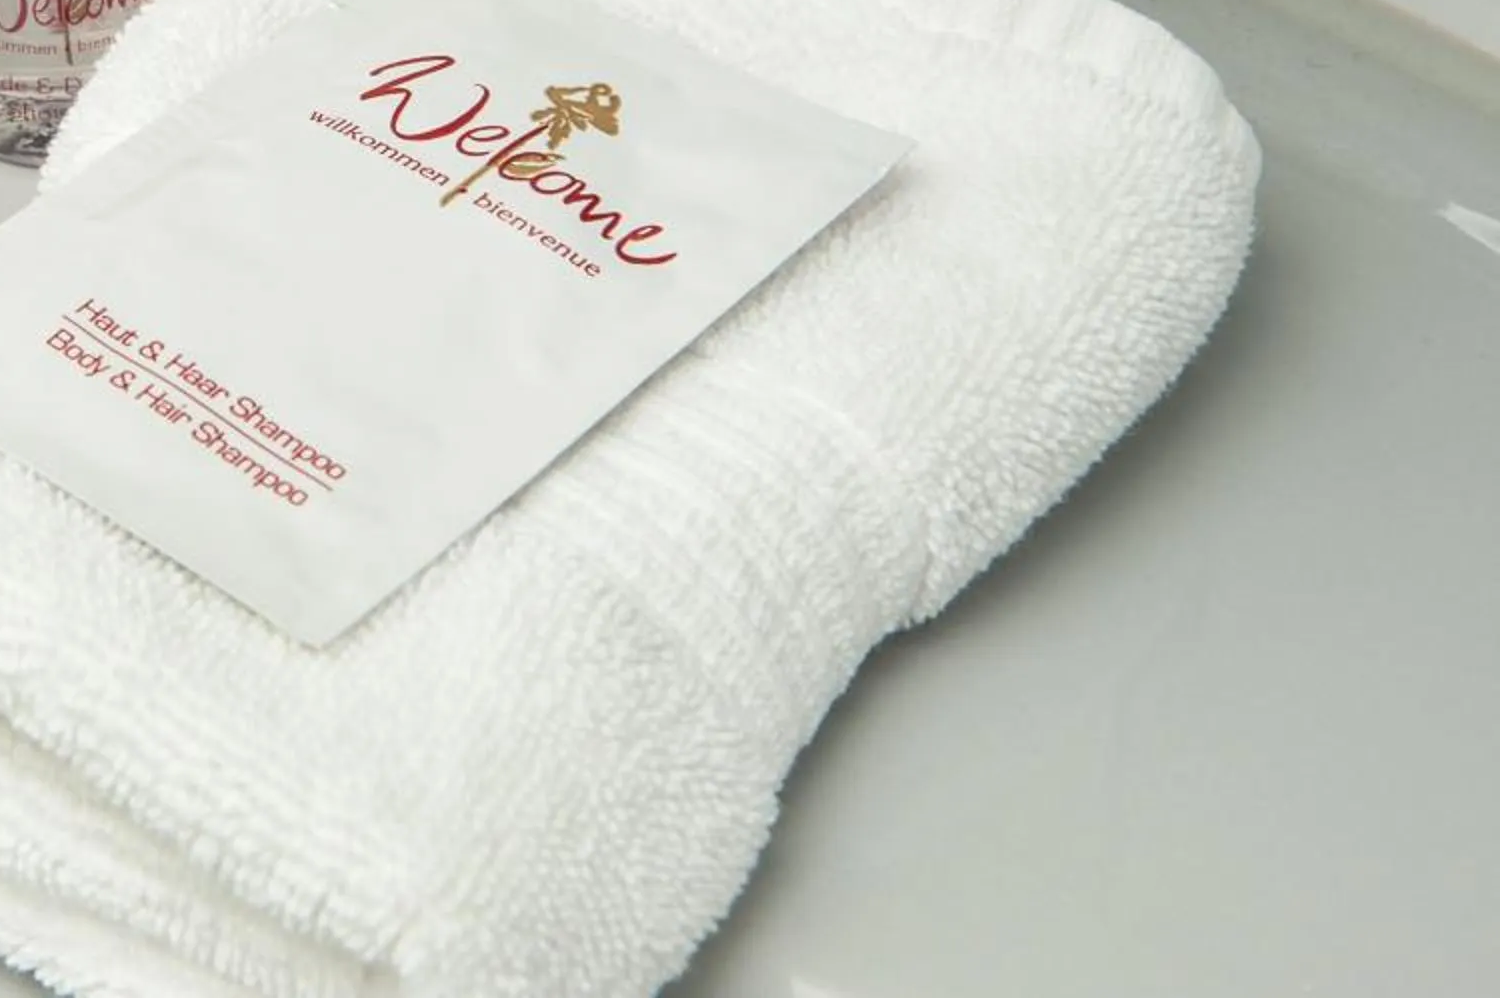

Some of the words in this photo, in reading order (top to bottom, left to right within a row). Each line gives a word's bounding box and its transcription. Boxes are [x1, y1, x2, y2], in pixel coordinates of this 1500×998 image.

[308, 108, 450, 187] willkommen
[472, 192, 602, 278] bienvenue
[360, 55, 678, 265] Welcome
[46, 328, 110, 377] Body
[109, 370, 136, 392] &
[134, 383, 193, 425] Hair
[191, 421, 309, 506] Shampoo
[75, 298, 138, 347] Haut
[139, 340, 165, 362] &
[164, 353, 230, 400] Haar
[229, 396, 346, 481] Shampoo
